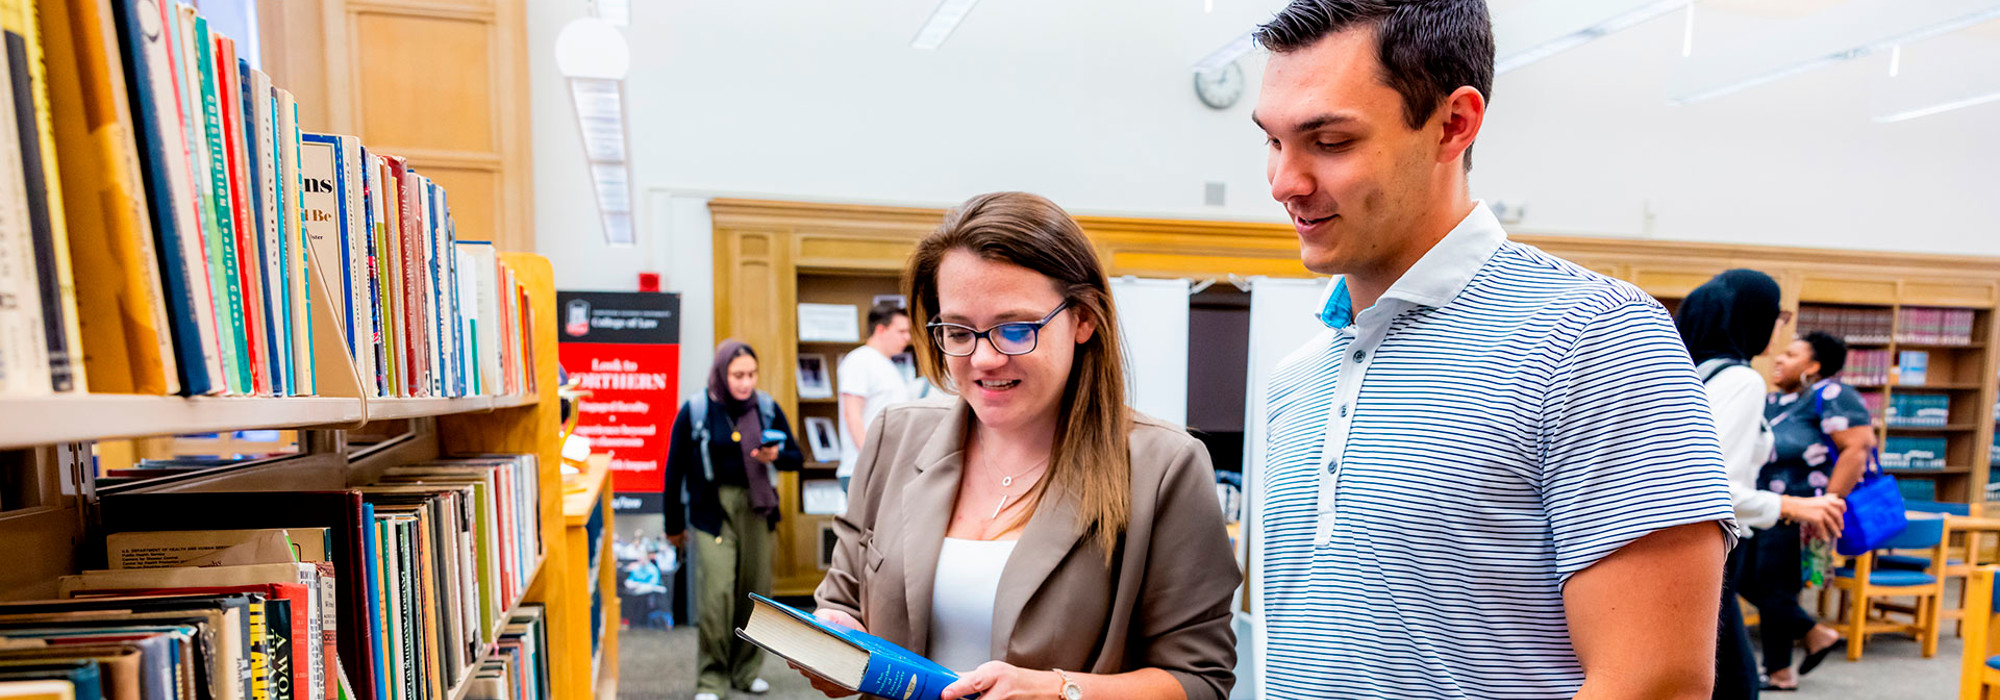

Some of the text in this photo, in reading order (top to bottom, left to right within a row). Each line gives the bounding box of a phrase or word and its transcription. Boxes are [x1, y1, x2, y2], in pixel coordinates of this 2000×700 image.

[207, 94, 240, 327] CONSTITUTION Leading Cases
[623, 359, 639, 372] to
[250, 603, 267, 645] THE
[276, 633, 288, 648] A
